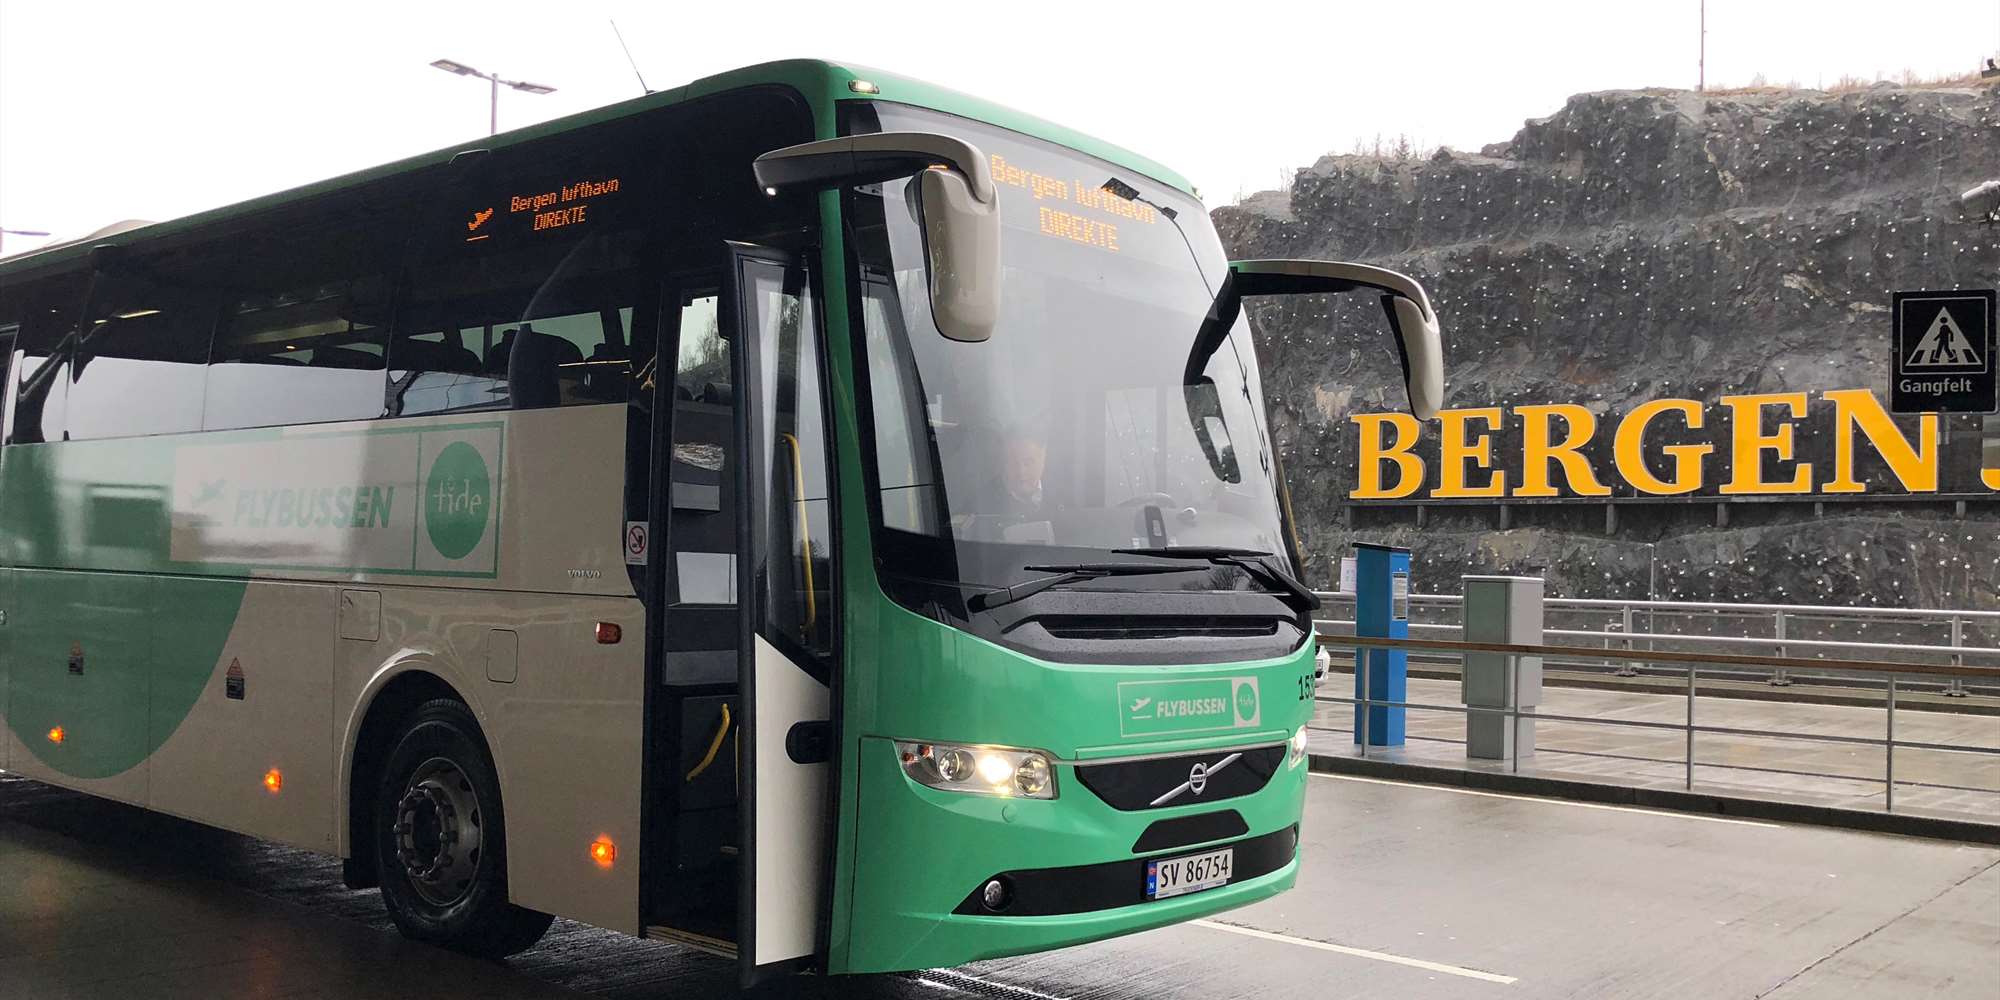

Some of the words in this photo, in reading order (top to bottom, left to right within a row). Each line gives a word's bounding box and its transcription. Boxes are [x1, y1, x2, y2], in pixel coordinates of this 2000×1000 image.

[511, 192, 557, 212] Bergen
[561, 178, 620, 202] lufthavn
[992, 154, 1068, 199] Bergen
[1075, 179, 1156, 224] lufthavn
[533, 205, 588, 231] DIREKTE
[1039, 206, 1119, 251] DIREKTE
[1900, 378, 1972, 396] Gangfelt
[1348, 388, 1939, 499] BERGEN
[232, 485, 395, 529] FLYBUSSEN
[432, 474, 482, 515] tide
[567, 568, 601, 578] VOLVO
[1156, 698, 1226, 718] FLYBUSSEN
[1161, 863, 1180, 888] SV
[1186, 854, 1229, 883] 86754
